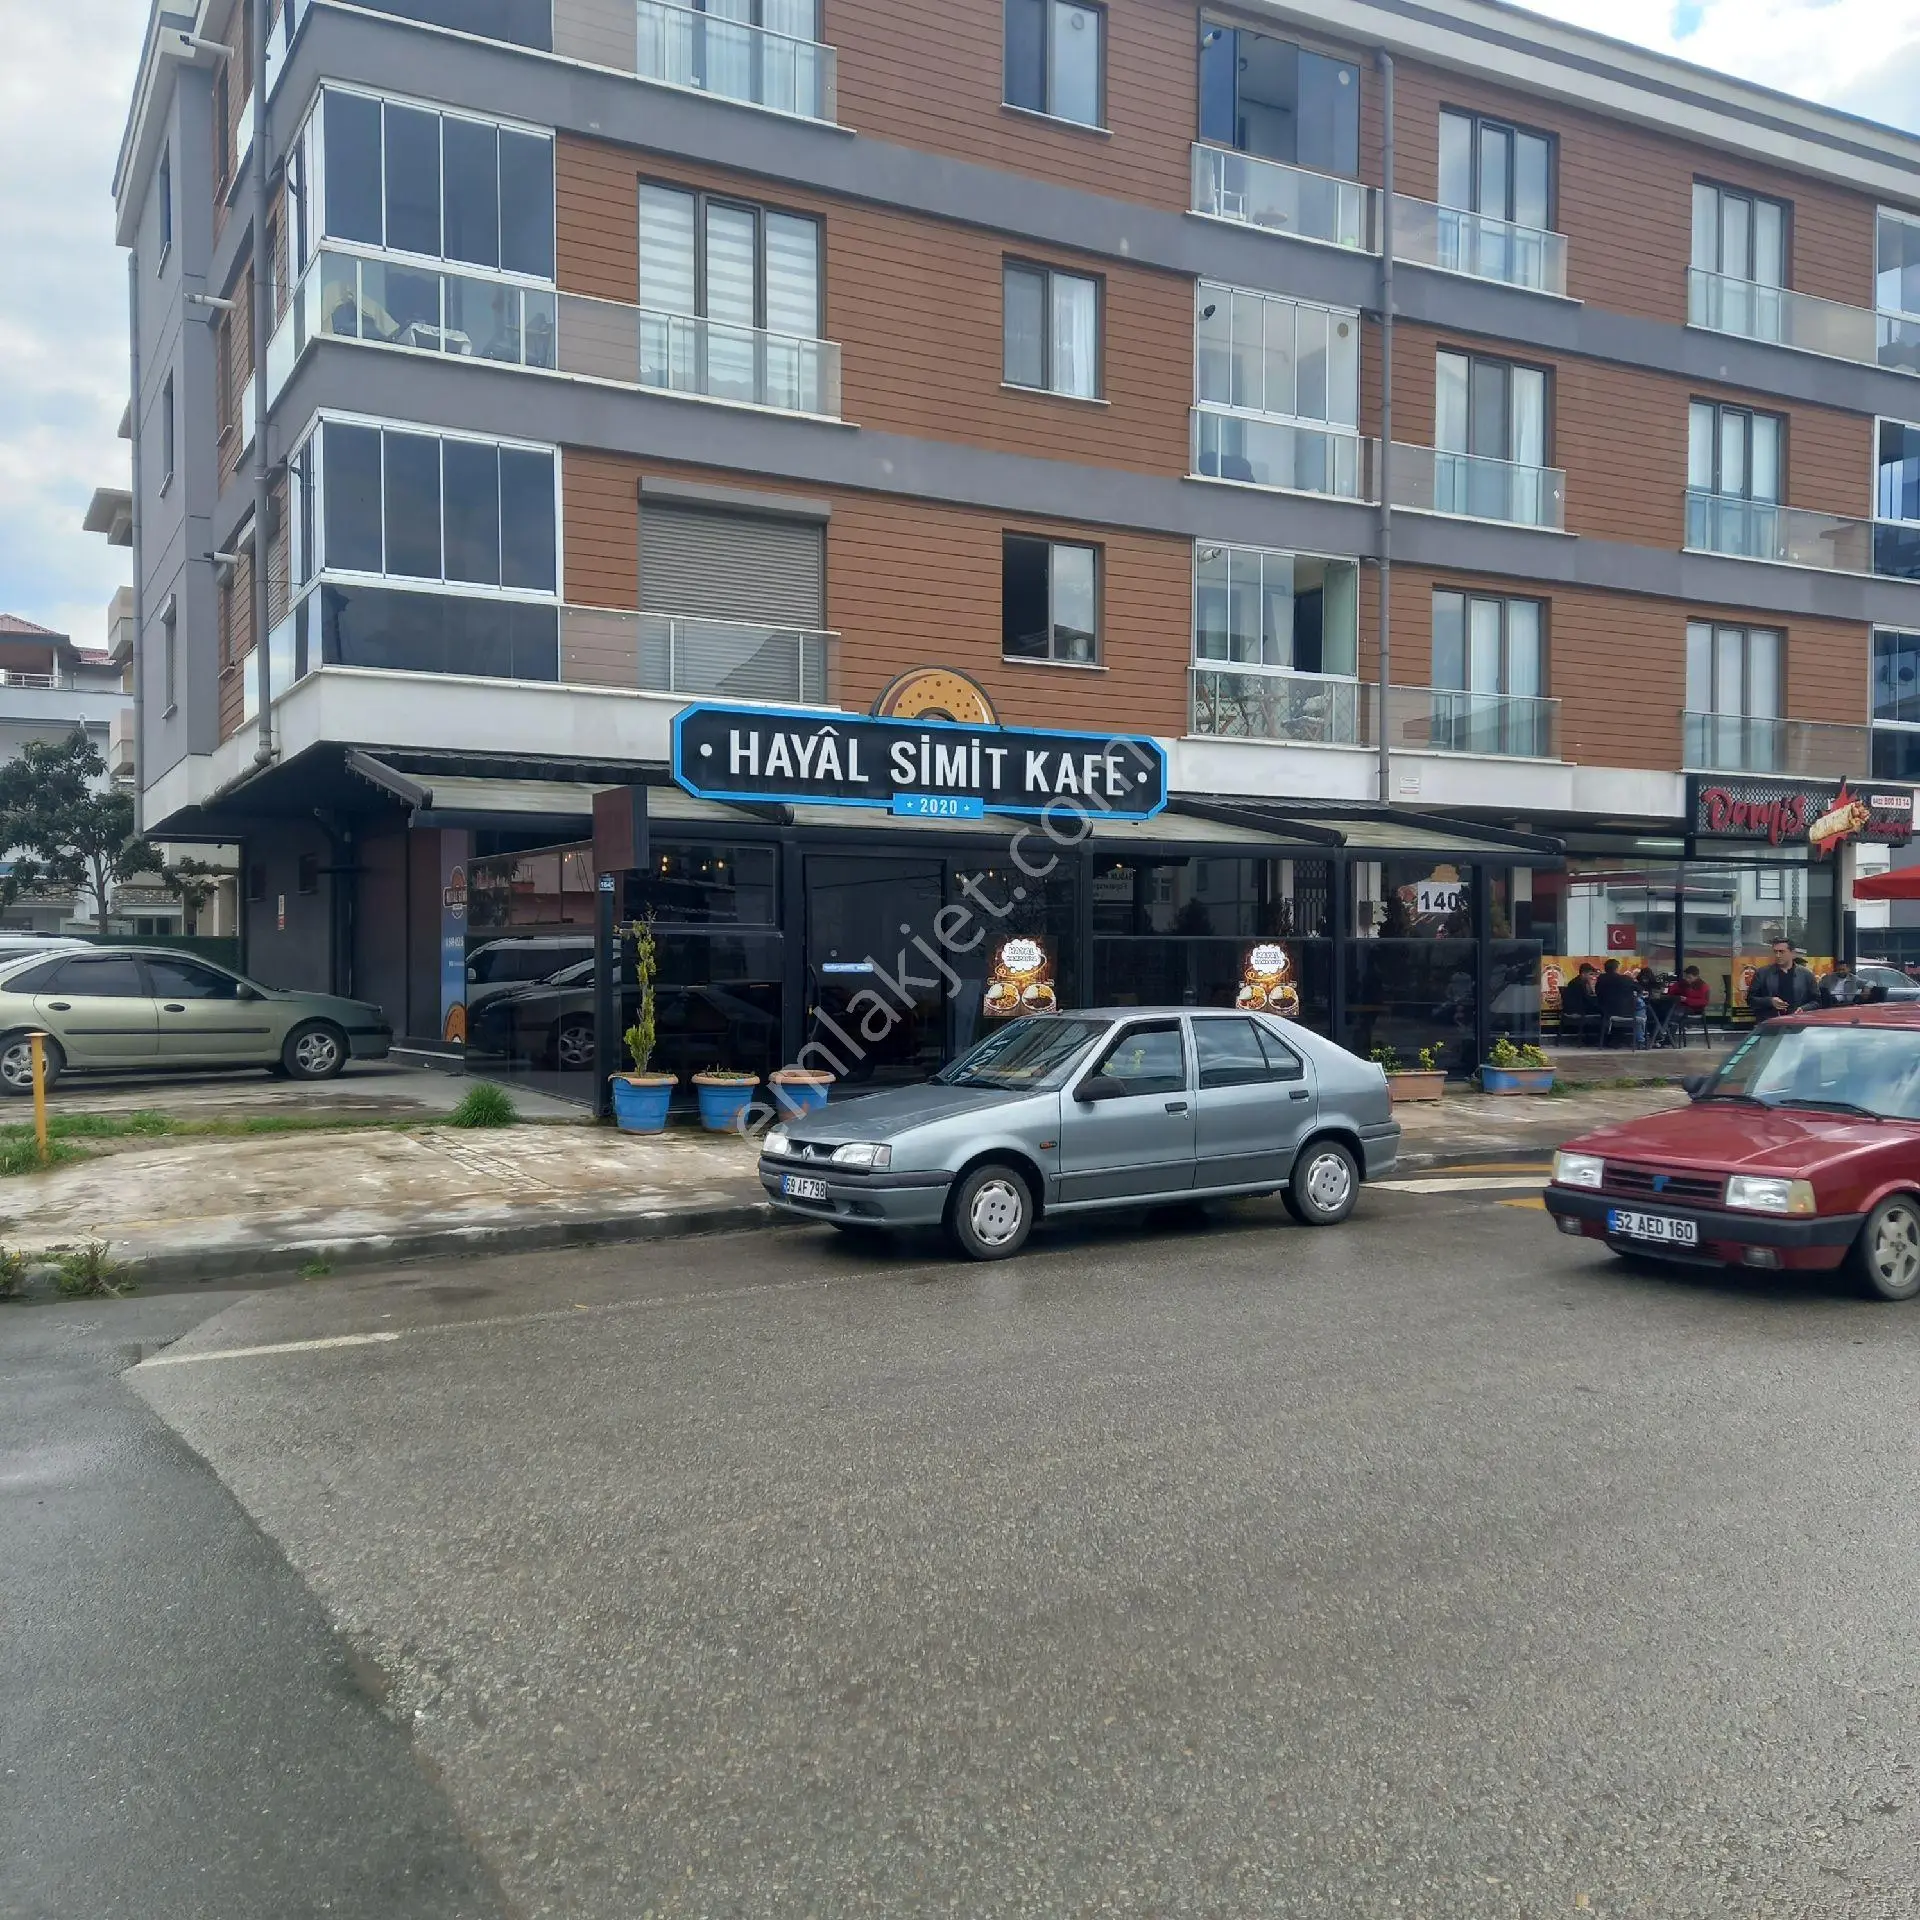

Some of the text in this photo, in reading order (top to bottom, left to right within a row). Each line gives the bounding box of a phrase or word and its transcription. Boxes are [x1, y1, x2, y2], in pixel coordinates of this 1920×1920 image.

[730, 725, 1124, 796] HAYÂL SİMİT KAFE
[920, 797, 957, 815] 2020
[1421, 891, 1460, 911] 140
[797, 1179, 808, 1194] AF
[809, 1181, 825, 1197] 798
[1616, 1212, 1633, 1230] 52
[1669, 1220, 1692, 1240] 160
